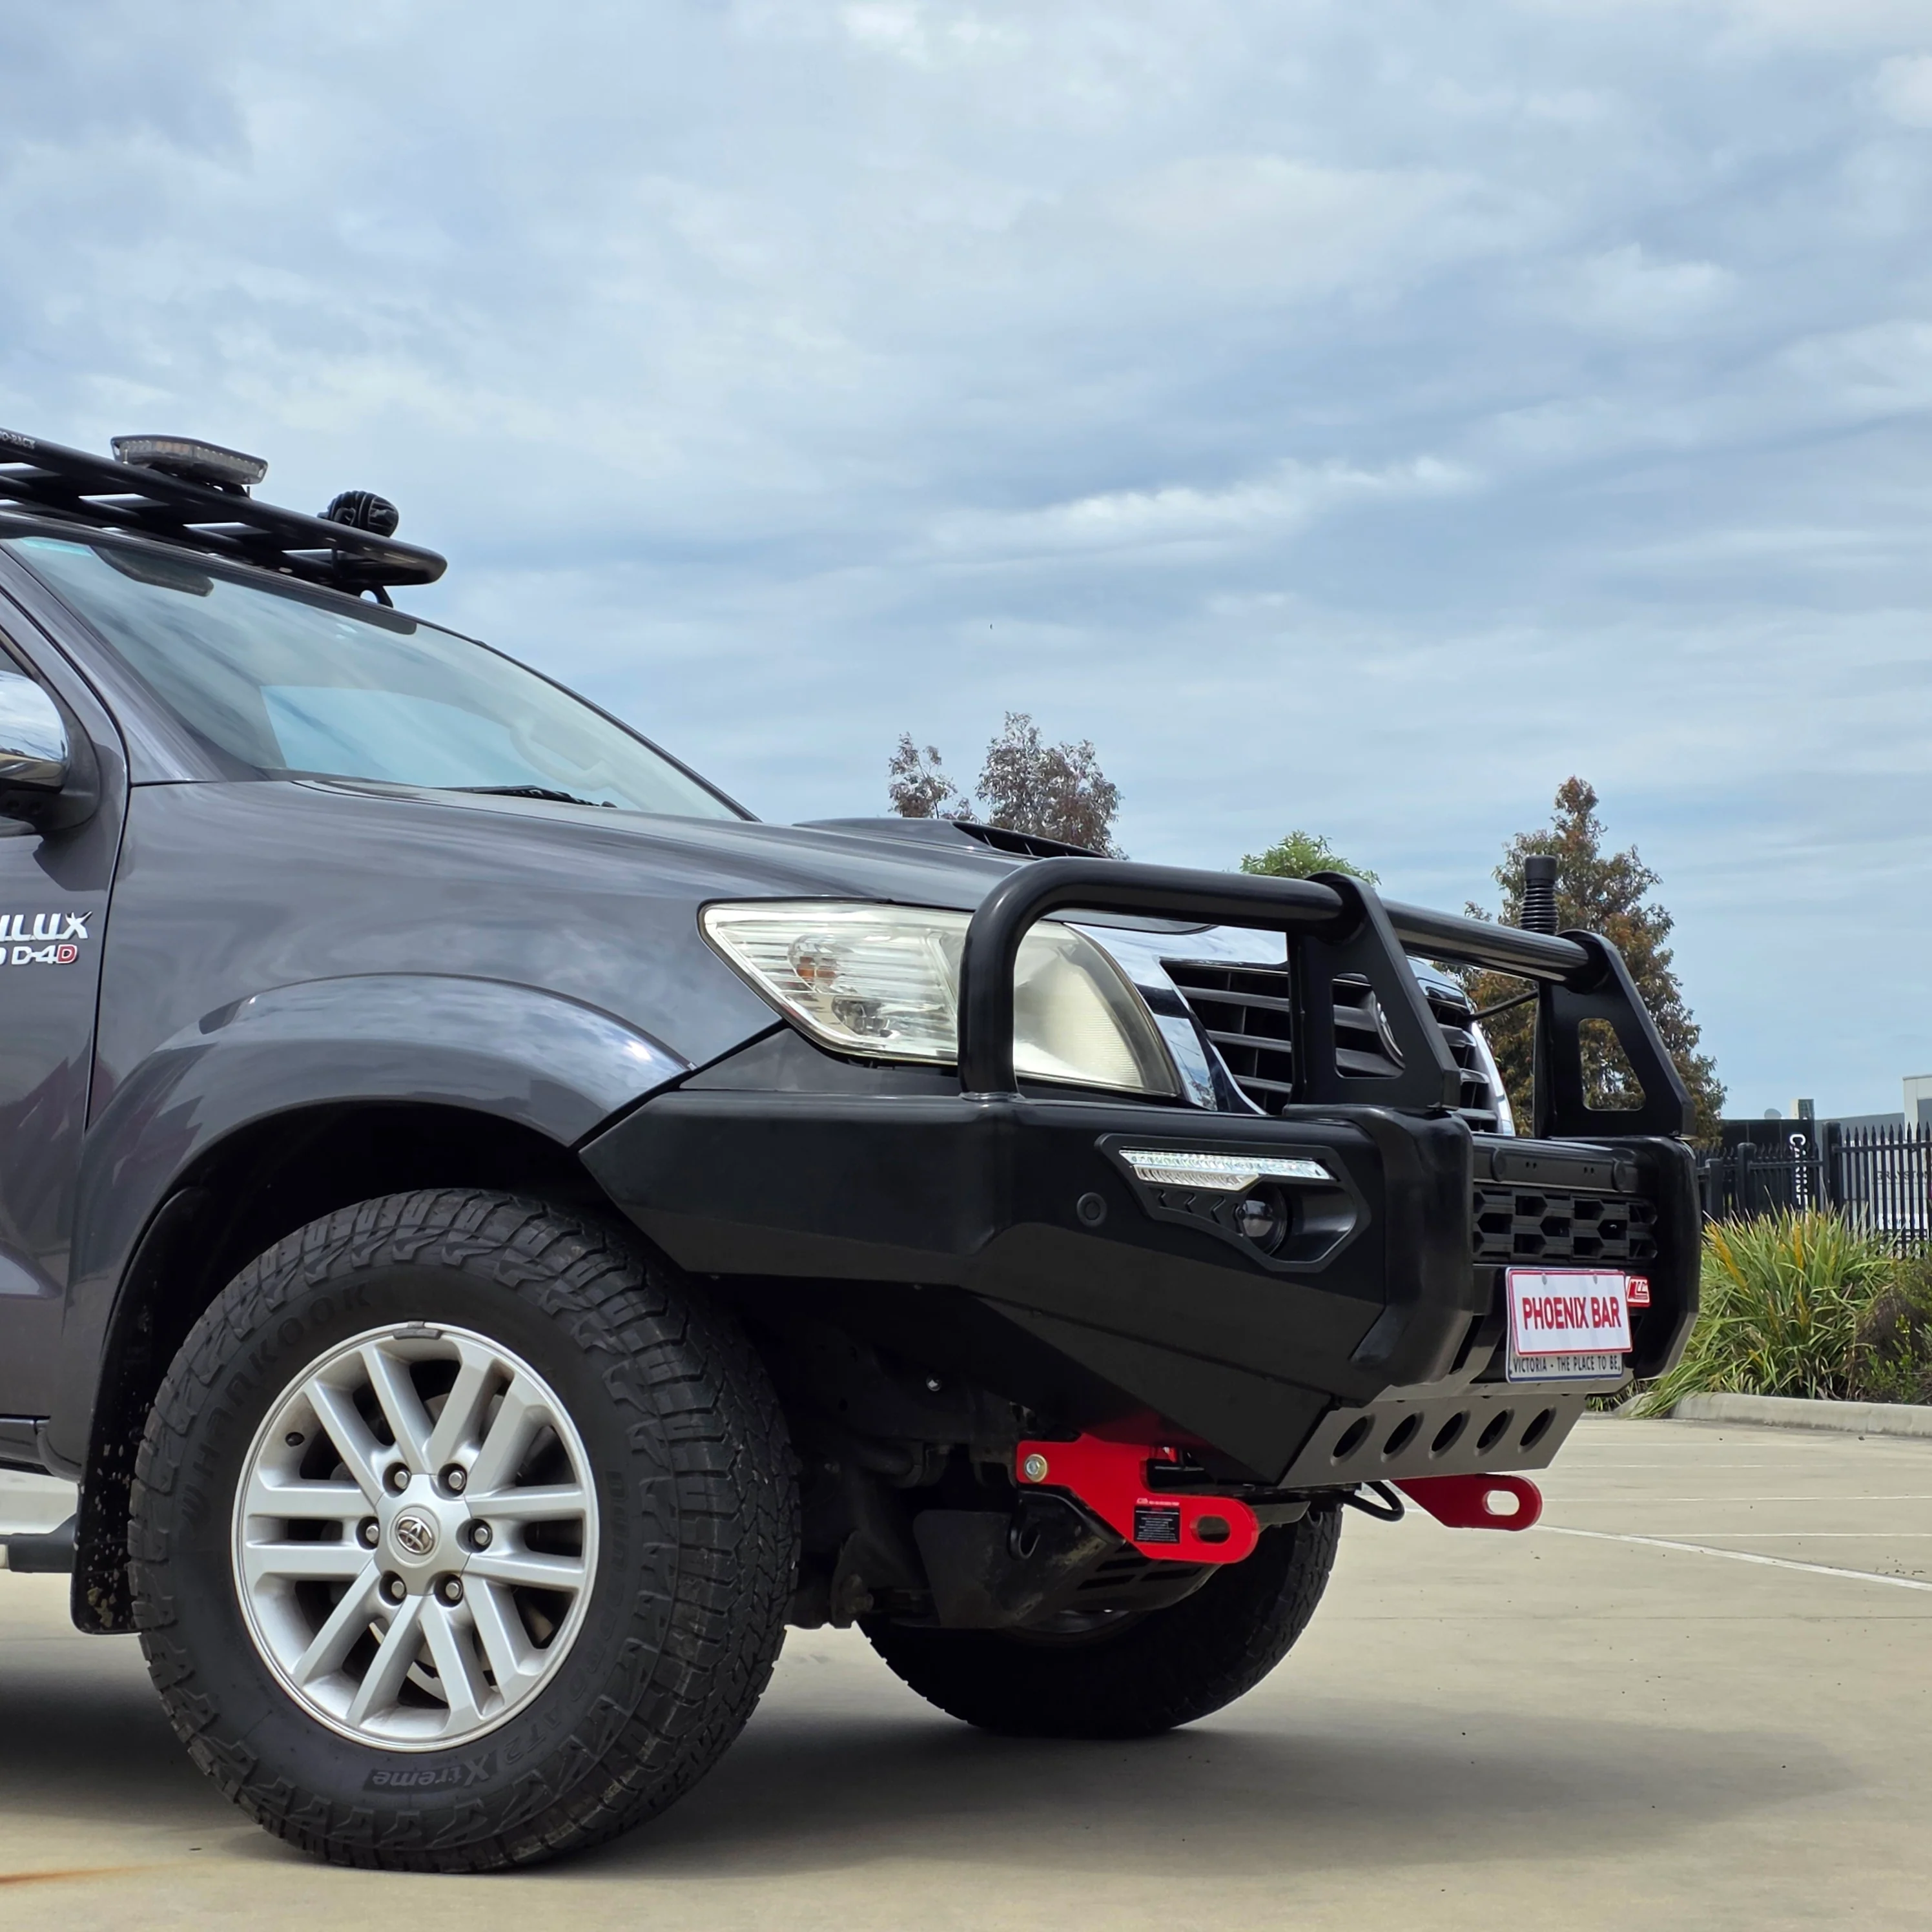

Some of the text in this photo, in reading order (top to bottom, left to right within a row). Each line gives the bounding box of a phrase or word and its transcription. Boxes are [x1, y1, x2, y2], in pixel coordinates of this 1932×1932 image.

[1521, 1296, 1622, 1330] PHOENIX BAR
[1513, 1356, 1548, 1373] VICTORIA
[1557, 1356, 1570, 1372] THE
[1573, 1355, 1595, 1372] PLACE
[1598, 1355, 1607, 1370] TO
[372, 1752, 491, 1787] Xtreme
